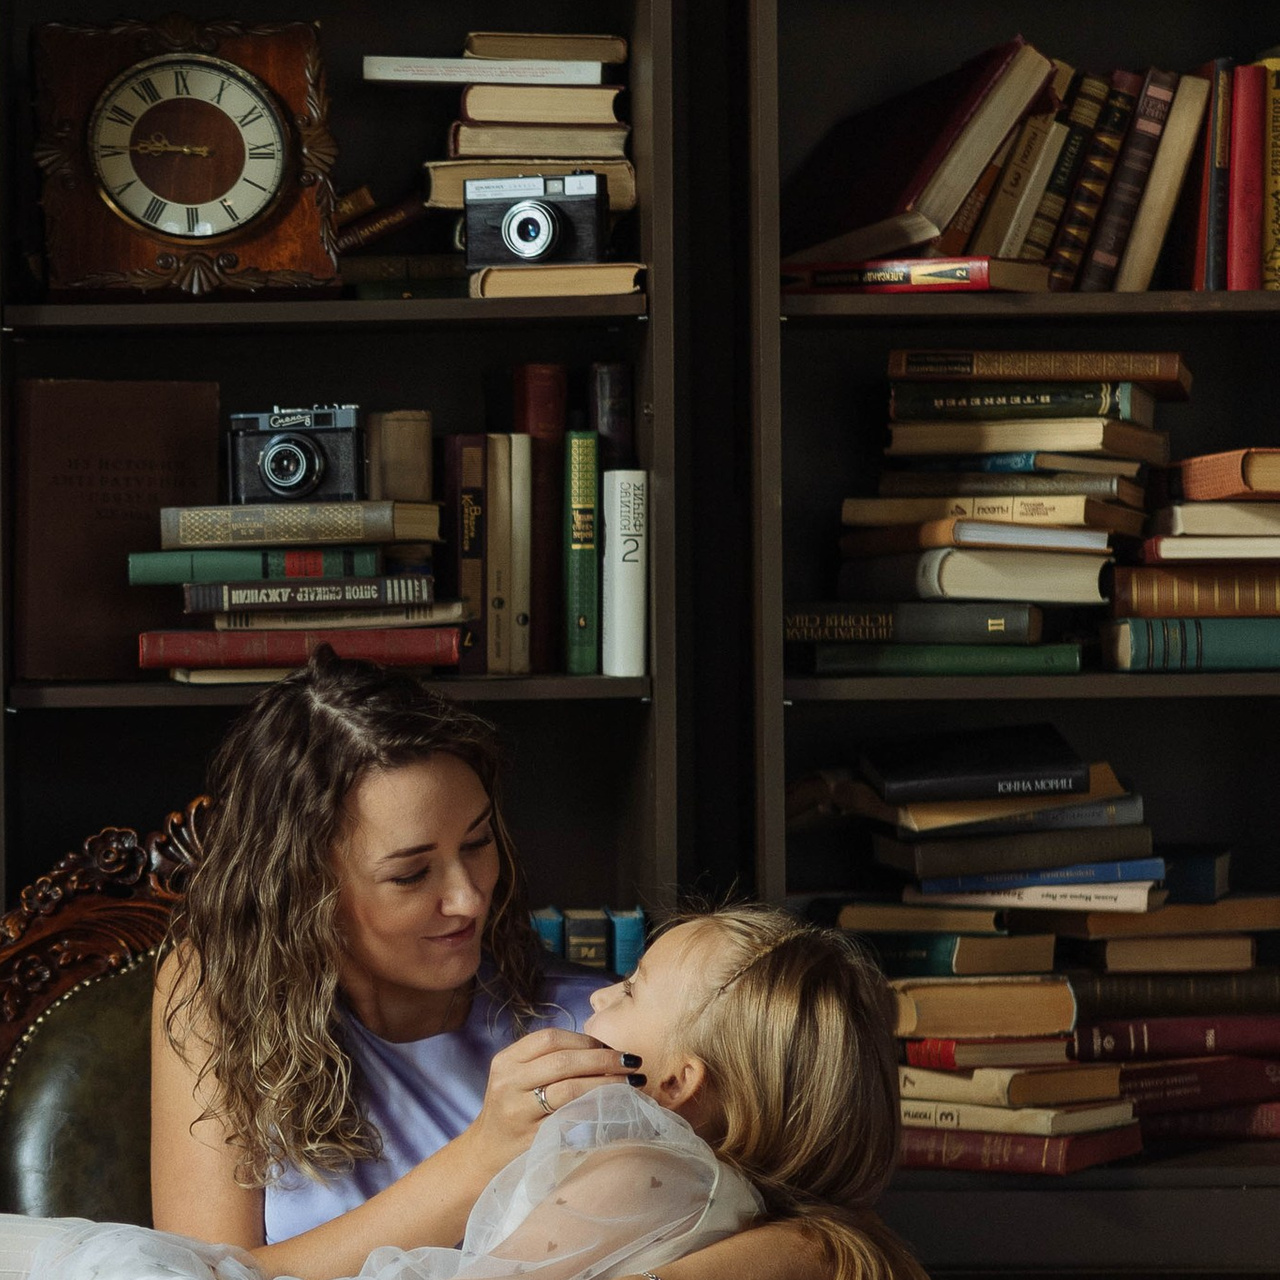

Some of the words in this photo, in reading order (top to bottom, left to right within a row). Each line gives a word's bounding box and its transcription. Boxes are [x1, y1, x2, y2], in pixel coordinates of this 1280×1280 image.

[131, 78, 162, 104] VIII
[174, 71, 191, 96] IX
[211, 80, 231, 105] X
[106, 105, 137, 127] VII
[235, 105, 264, 128] XI
[248, 142, 275, 160] XII
[243, 177, 267, 192] I
[186, 207, 200, 233] III
[620, 481, 632, 532] ЮЛИУС
[632, 483, 645, 532] ФУЧИК
[622, 538, 639, 563] 2
[231, 587, 291, 605] ДЖУНГЛИ
[346, 584, 378, 599] ЭПТОН
[823, 614, 894, 628] ИСТОРИЯ
[786, 627, 894, 641] ЛИТЕРАТУРНАЯ
[996, 780, 1032, 796] ЮННА
[1034, 777, 1074, 793] МОРИЦ
